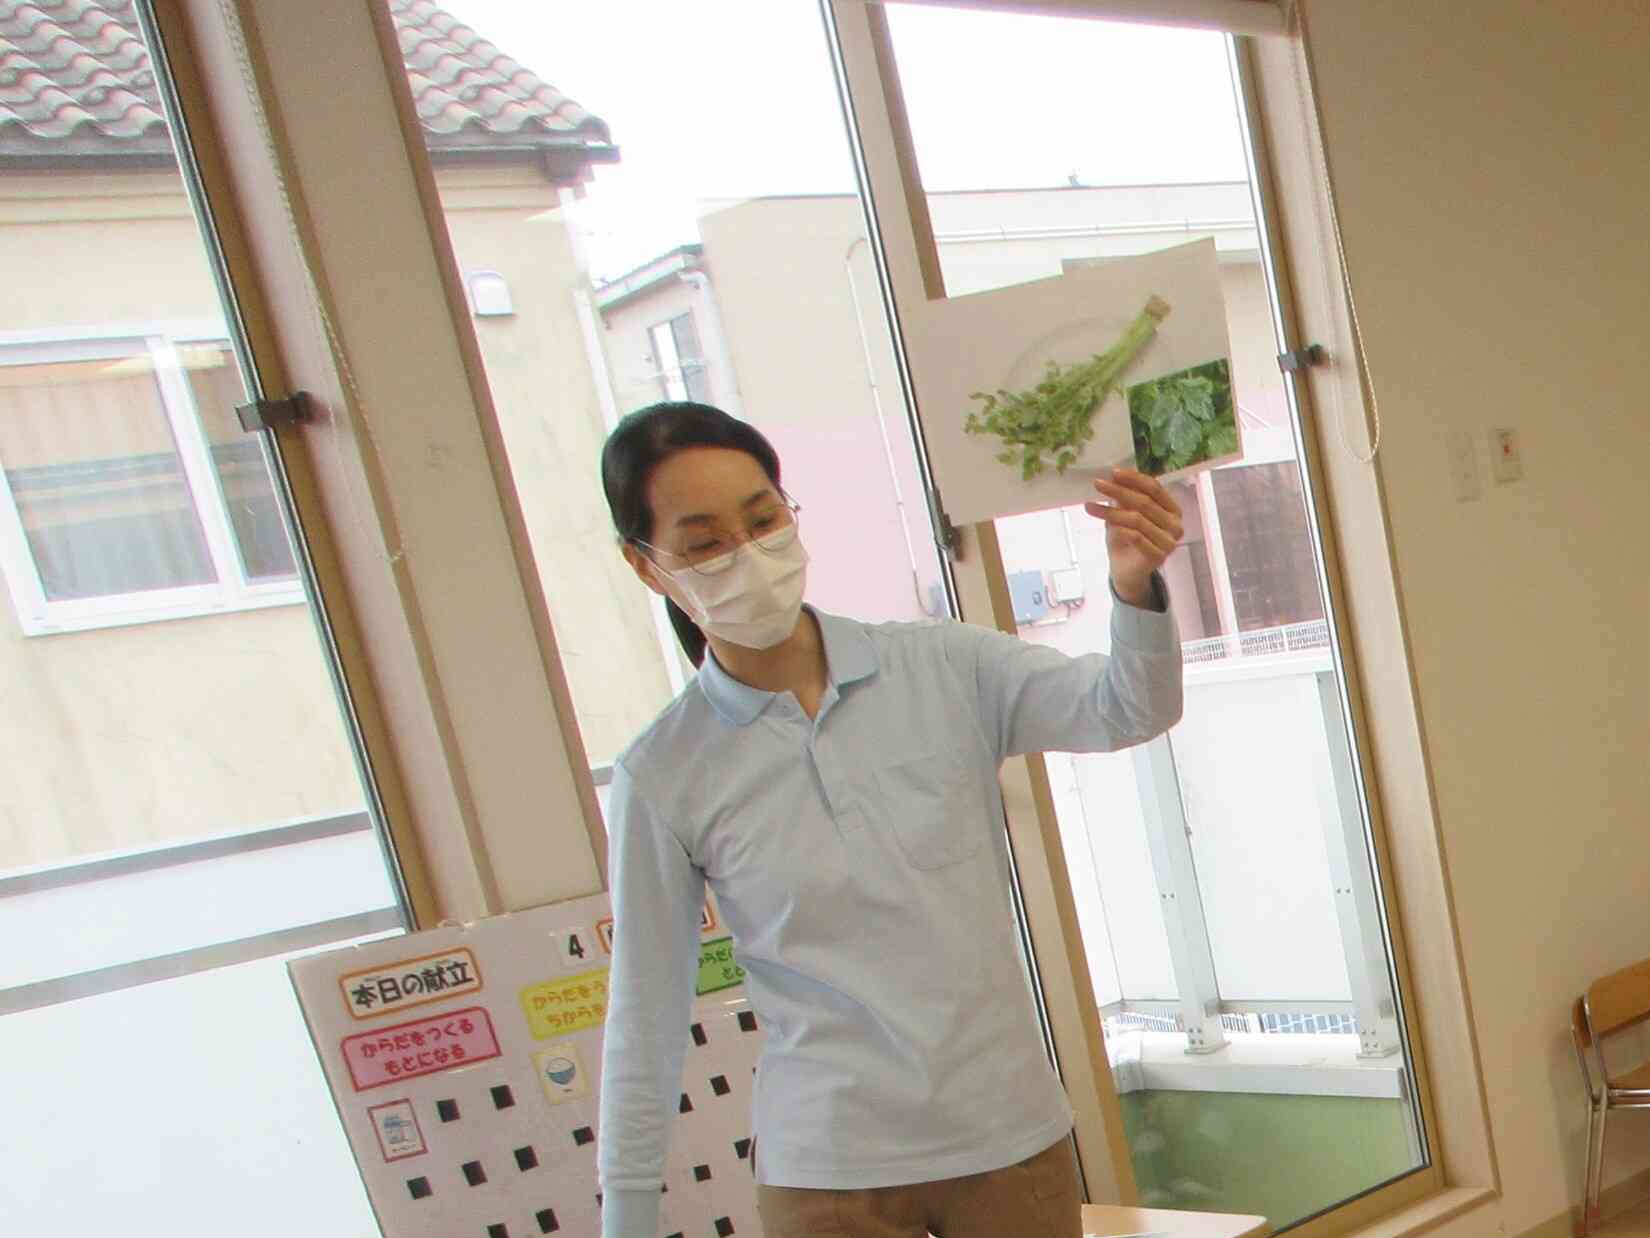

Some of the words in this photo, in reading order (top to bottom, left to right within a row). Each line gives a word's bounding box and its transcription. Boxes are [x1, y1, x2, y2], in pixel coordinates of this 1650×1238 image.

[568, 933, 584, 959] 4
[351, 961, 474, 1008] 本日の献立
[360, 1018, 474, 1058] からだをつくる
[384, 1044, 466, 1075] もとになる
